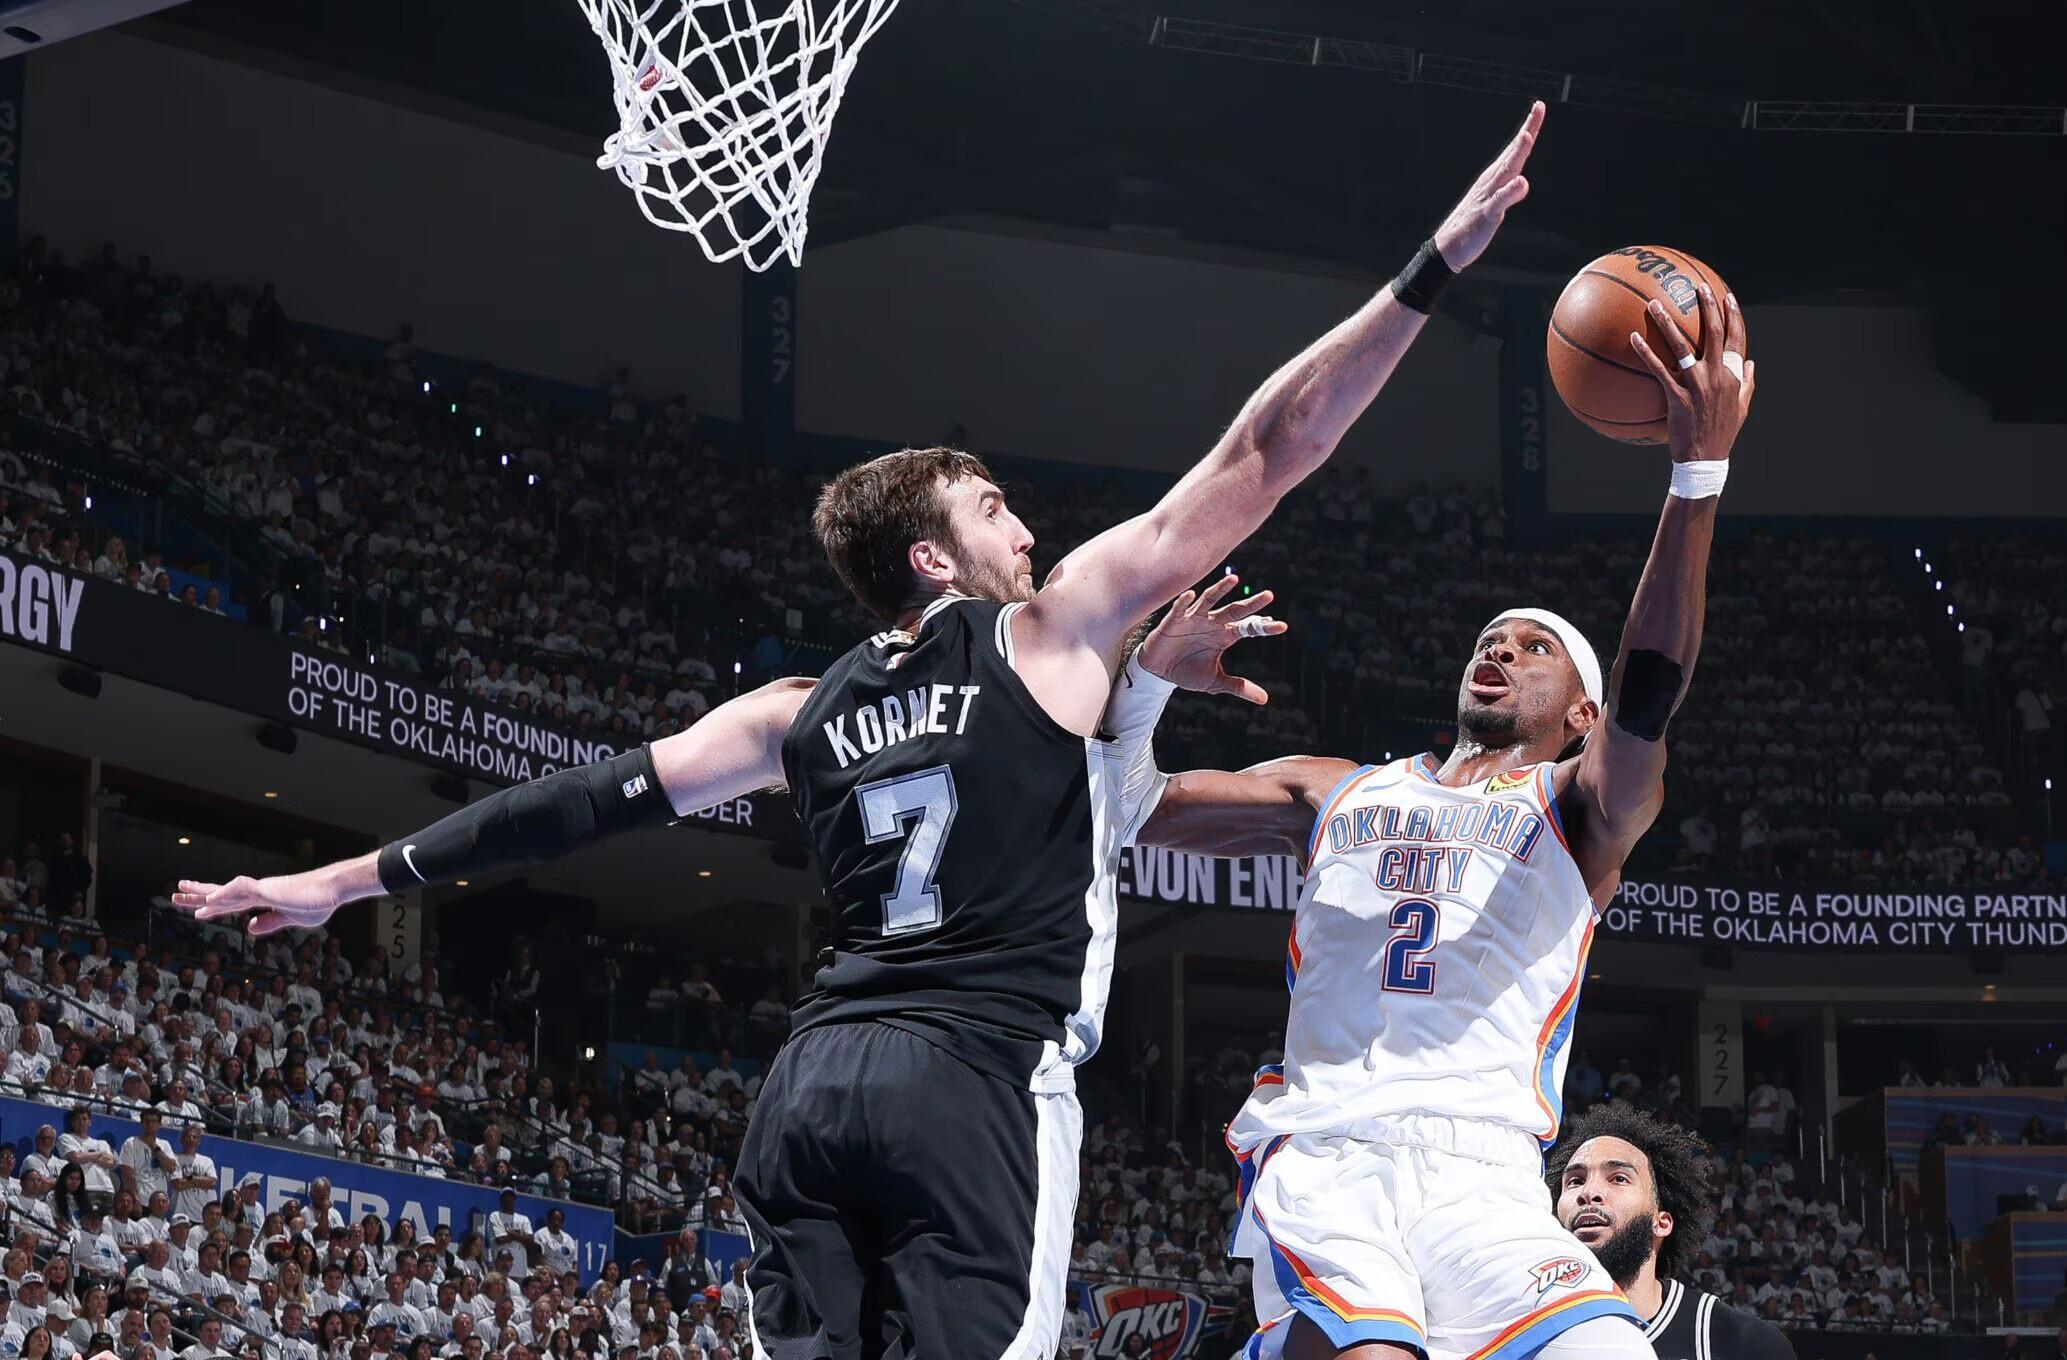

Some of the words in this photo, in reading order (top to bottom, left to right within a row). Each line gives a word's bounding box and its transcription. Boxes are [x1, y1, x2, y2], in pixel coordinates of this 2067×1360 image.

[771, 296, 791, 384] 327
[1521, 387, 1541, 471] 328
[288, 687, 324, 720] OF
[332, 698, 382, 739] THE
[390, 717, 533, 781] OKLAHOMA
[291, 651, 378, 702] PROUD
[384, 680, 418, 715] TO
[425, 693, 454, 728] BE
[460, 706, 477, 735] A
[483, 711, 616, 766] FOUNDING
[822, 683, 981, 769] KORNET
[853, 763, 959, 937] 7
[1328, 800, 1545, 864] OKLAHOMA
[1375, 846, 1473, 894] CITY
[1606, 908, 1643, 932] OF
[1652, 911, 1704, 937] THE
[1713, 916, 1880, 945] OKLAHOMA
[1889, 921, 1956, 945] CITY
[1966, 922, 2067, 945] THUND
[1705, 888, 1740, 913] TO
[1748, 891, 1781, 916] BE
[1788, 894, 1808, 917] A
[1816, 894, 1966, 919] FOUNDING
[1974, 895, 2067, 919] PARTN
[1380, 897, 1441, 995] 2
[1713, 1023, 1728, 1096] 227
[1538, 1261, 1579, 1293] OKC
[1097, 1299, 1186, 1357] OKC
